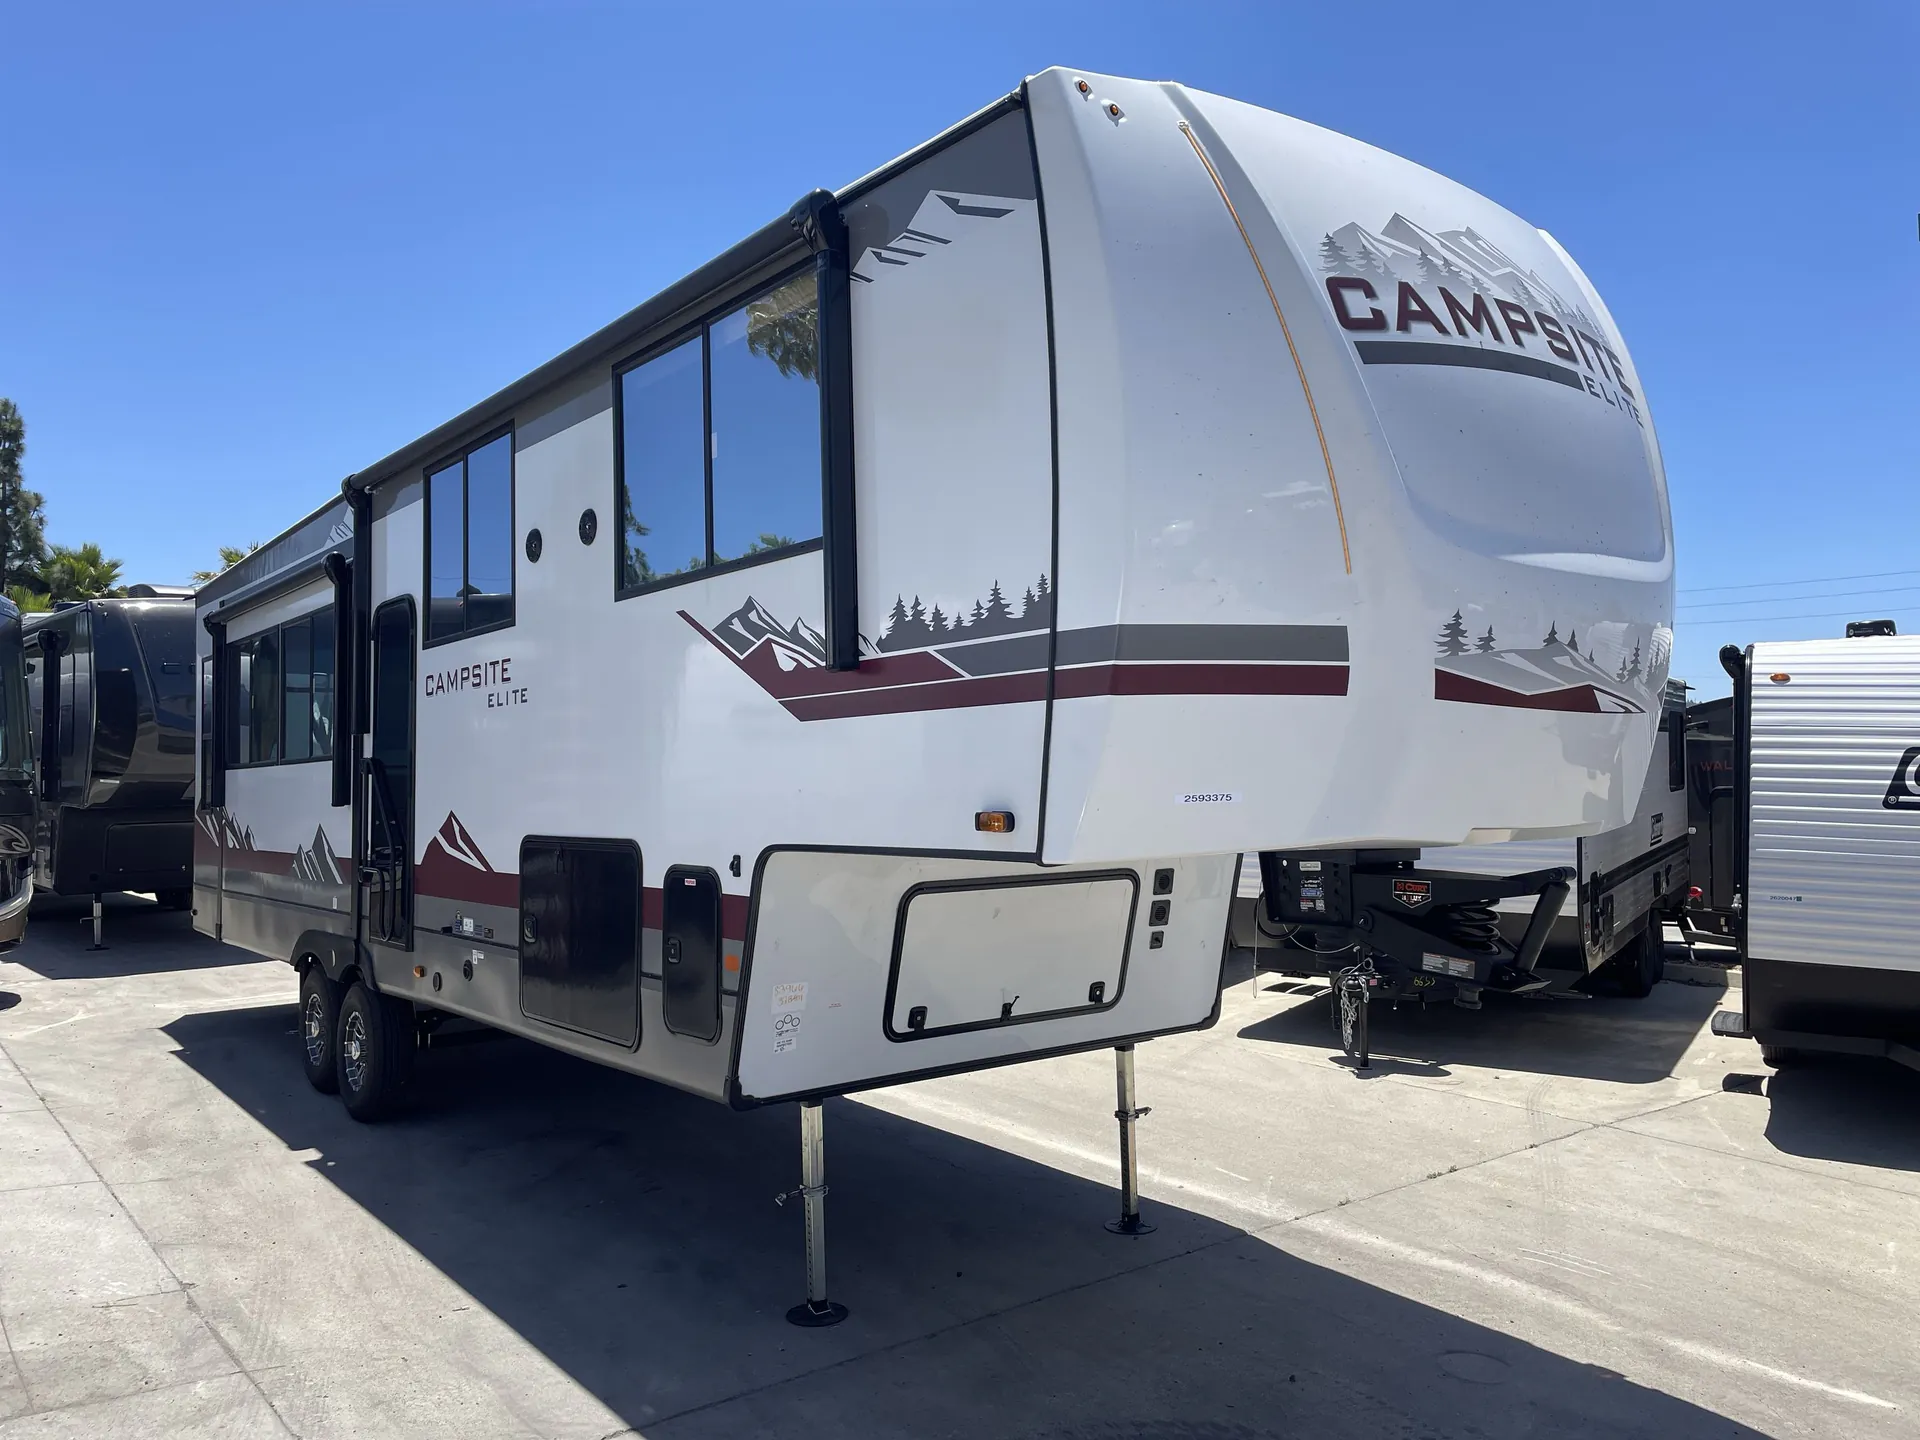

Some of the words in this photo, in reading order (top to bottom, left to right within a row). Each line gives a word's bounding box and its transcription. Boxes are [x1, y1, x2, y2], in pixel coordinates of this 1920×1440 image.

[1325, 275, 1635, 400] CAMPSITE
[1583, 374, 1645, 429] ELITE
[425, 657, 512, 697] CAMPSITE
[487, 687, 528, 708] ELITE
[1184, 793, 1233, 803] 2593375
